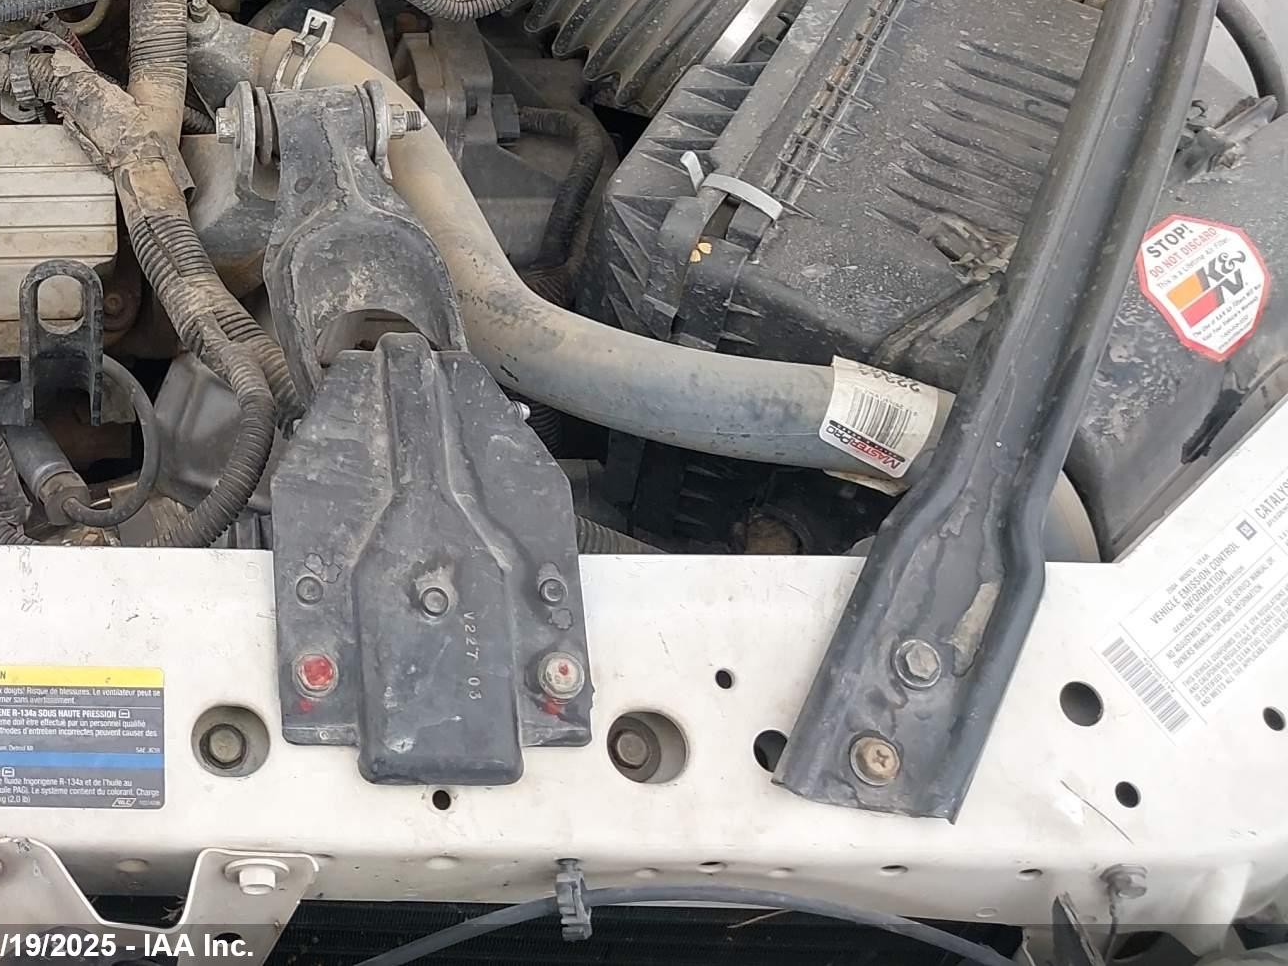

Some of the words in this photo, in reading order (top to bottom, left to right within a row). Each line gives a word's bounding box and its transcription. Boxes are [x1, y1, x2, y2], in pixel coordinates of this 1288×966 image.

[1147, 223, 1193, 258] STOP!
[1150, 265, 1164, 277] DO
[1162, 252, 1184, 270] NOT
[1180, 227, 1217, 255] DISCARD
[1149, 595, 1180, 625] VEHICLE
[1176, 566, 1212, 599] EMISSION
[1207, 540, 1240, 571] CONTROL
[1180, 566, 1228, 611] INFORMATION
[38, 708, 56, 718] SOUS
[59, 708, 80, 718] HAUTE
[82, 709, 116, 718] PRESSION
